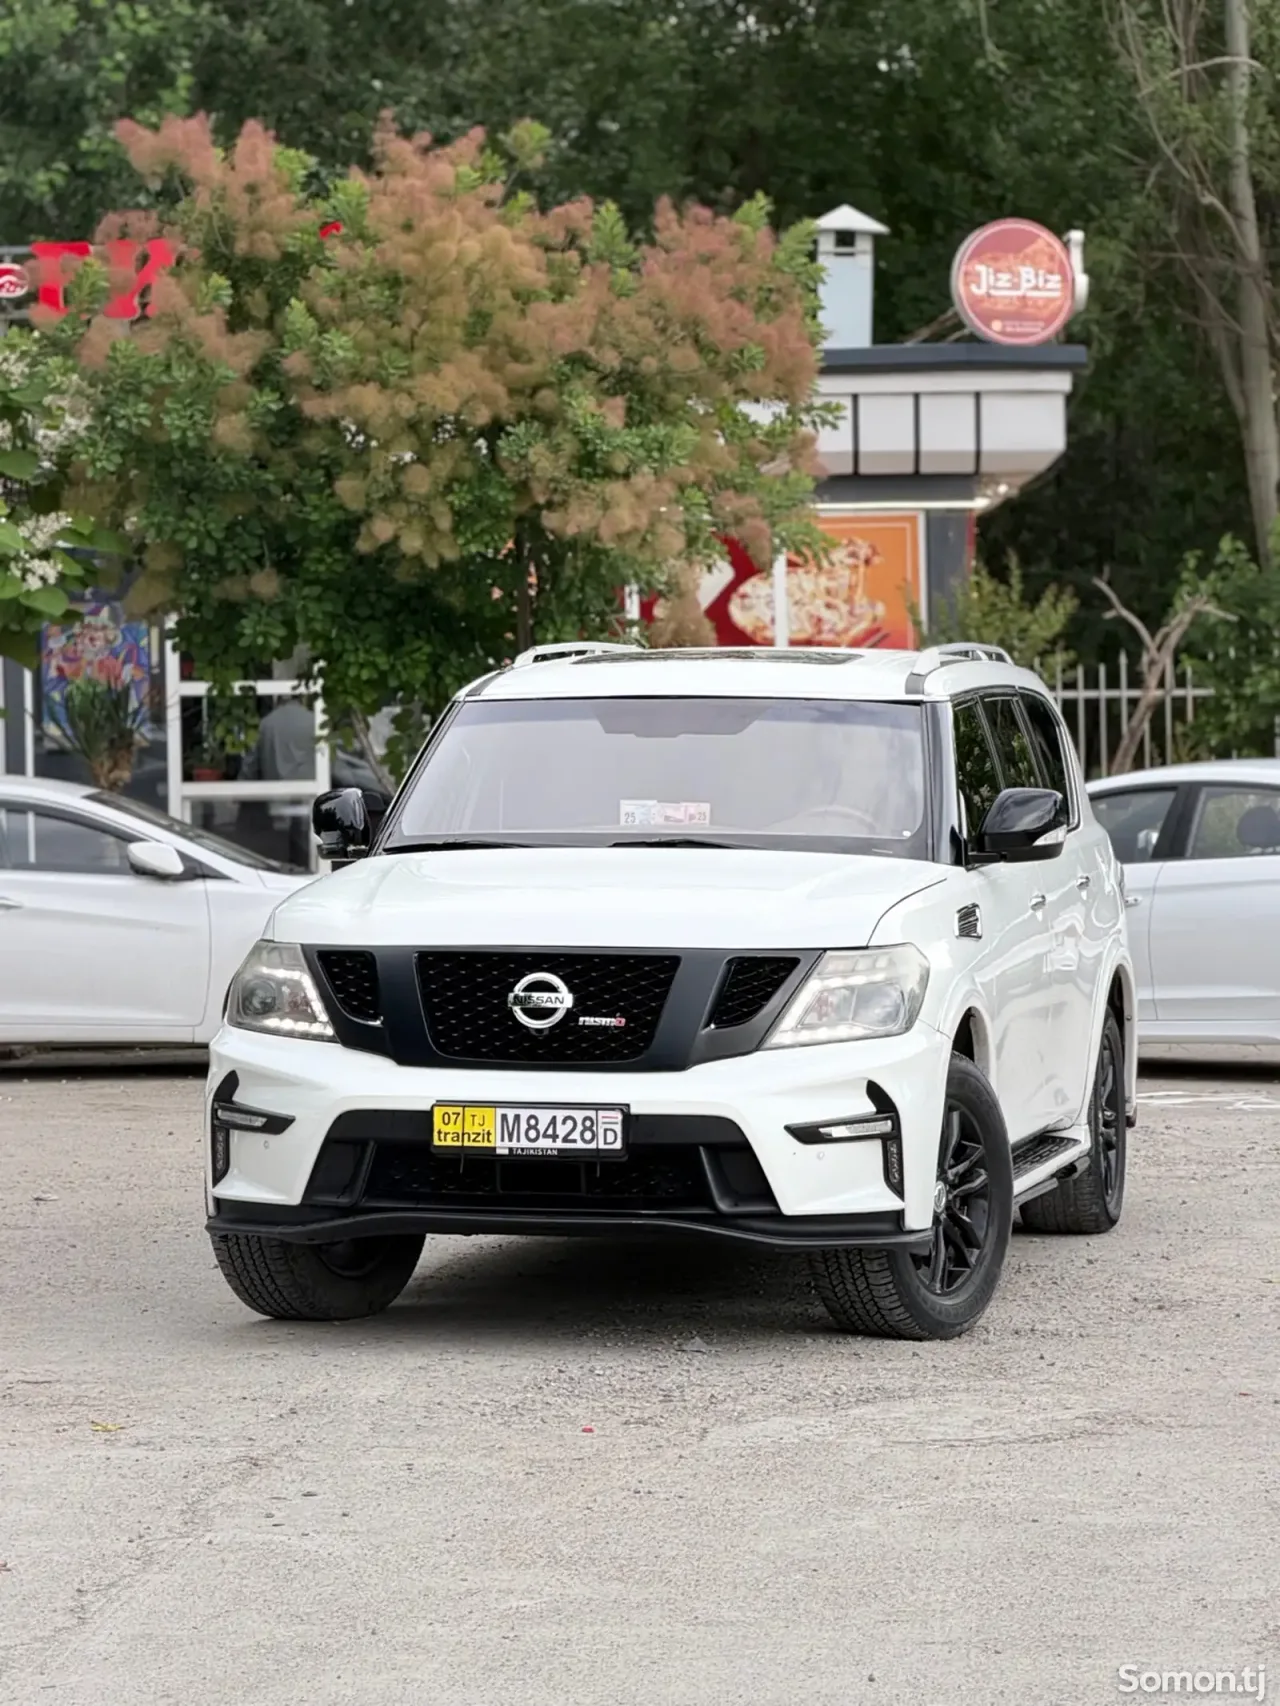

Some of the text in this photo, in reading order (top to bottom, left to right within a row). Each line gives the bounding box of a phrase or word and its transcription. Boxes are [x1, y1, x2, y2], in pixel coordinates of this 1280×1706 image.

[624, 811, 637, 824] 25
[512, 994, 565, 1005] NISSAN
[441, 1112, 485, 1127] 07 TJ
[436, 1128, 492, 1144] tranzit
[500, 1113, 596, 1144] M8428
[603, 1127, 618, 1146] D
[512, 1147, 558, 1156] TAJIKISTAN
